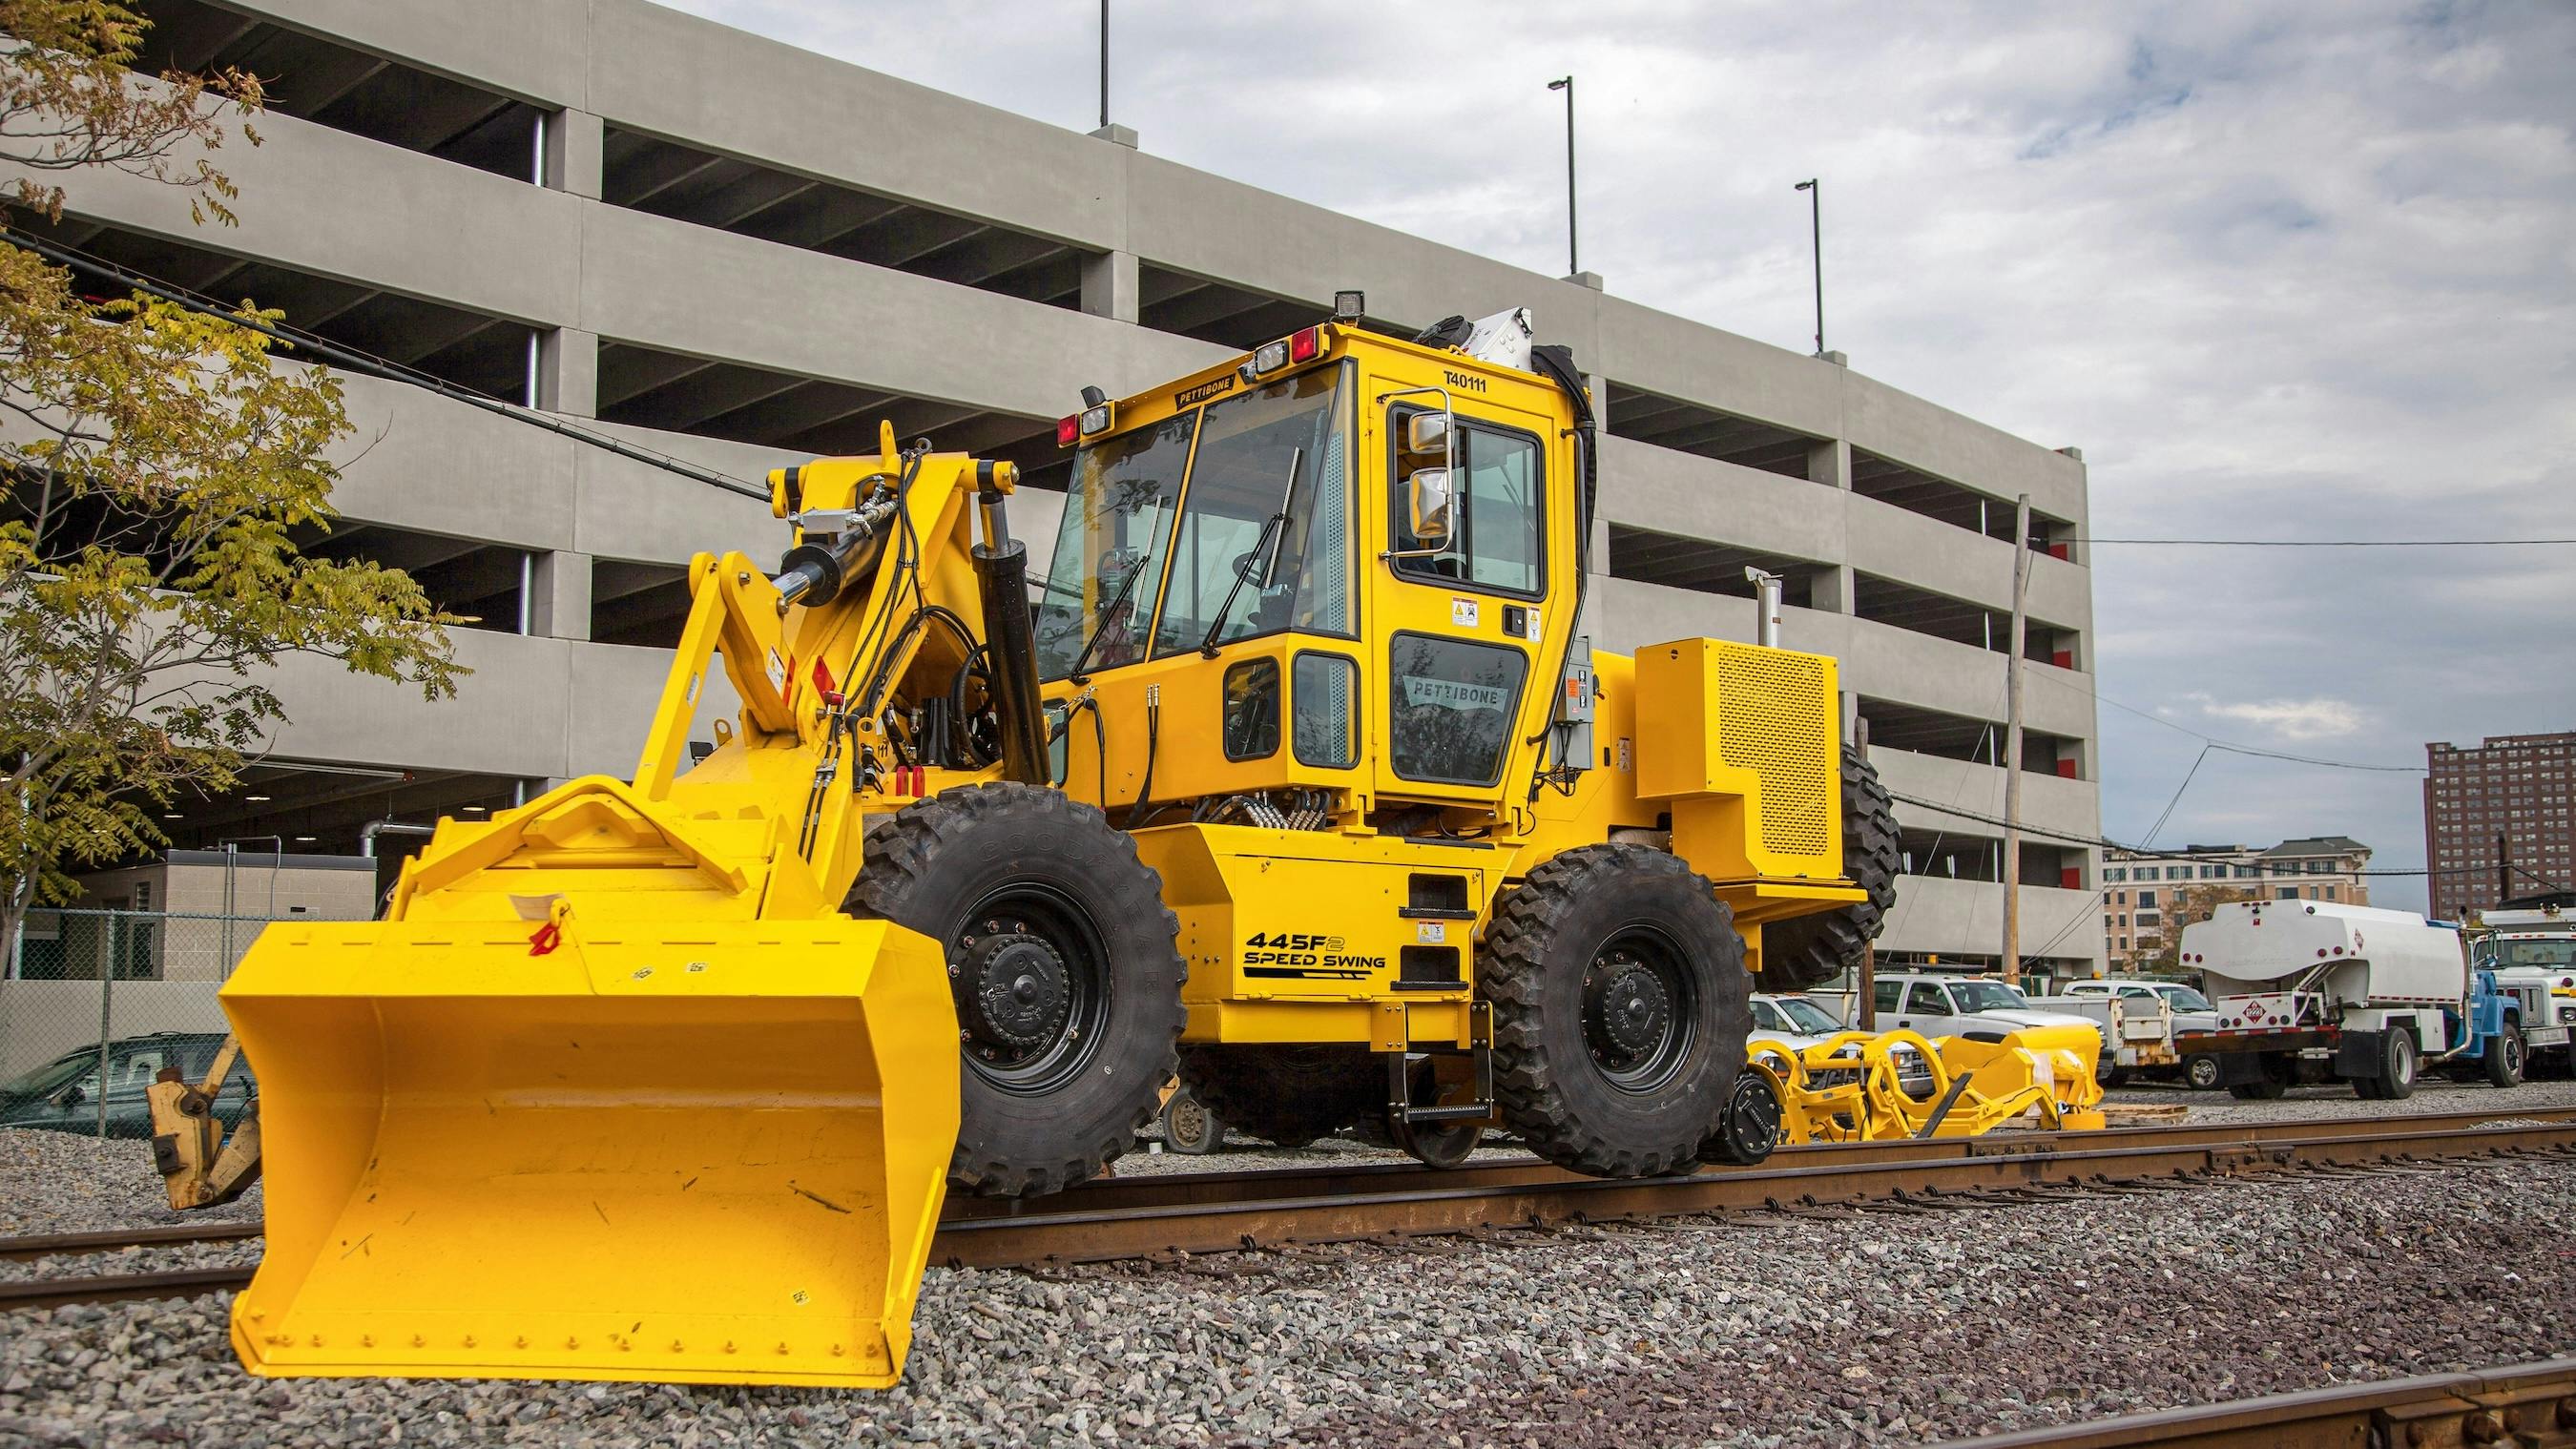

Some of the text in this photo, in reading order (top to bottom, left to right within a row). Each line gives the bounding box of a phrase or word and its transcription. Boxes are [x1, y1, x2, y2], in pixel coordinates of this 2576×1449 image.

[1179, 377, 1231, 404] PETTIBONE
[1444, 370, 1486, 393] T40111
[1414, 682, 1498, 704] PETTIBONE
[1246, 932, 1345, 952] 445F2
[1244, 952, 1385, 968] SPEED SWING
